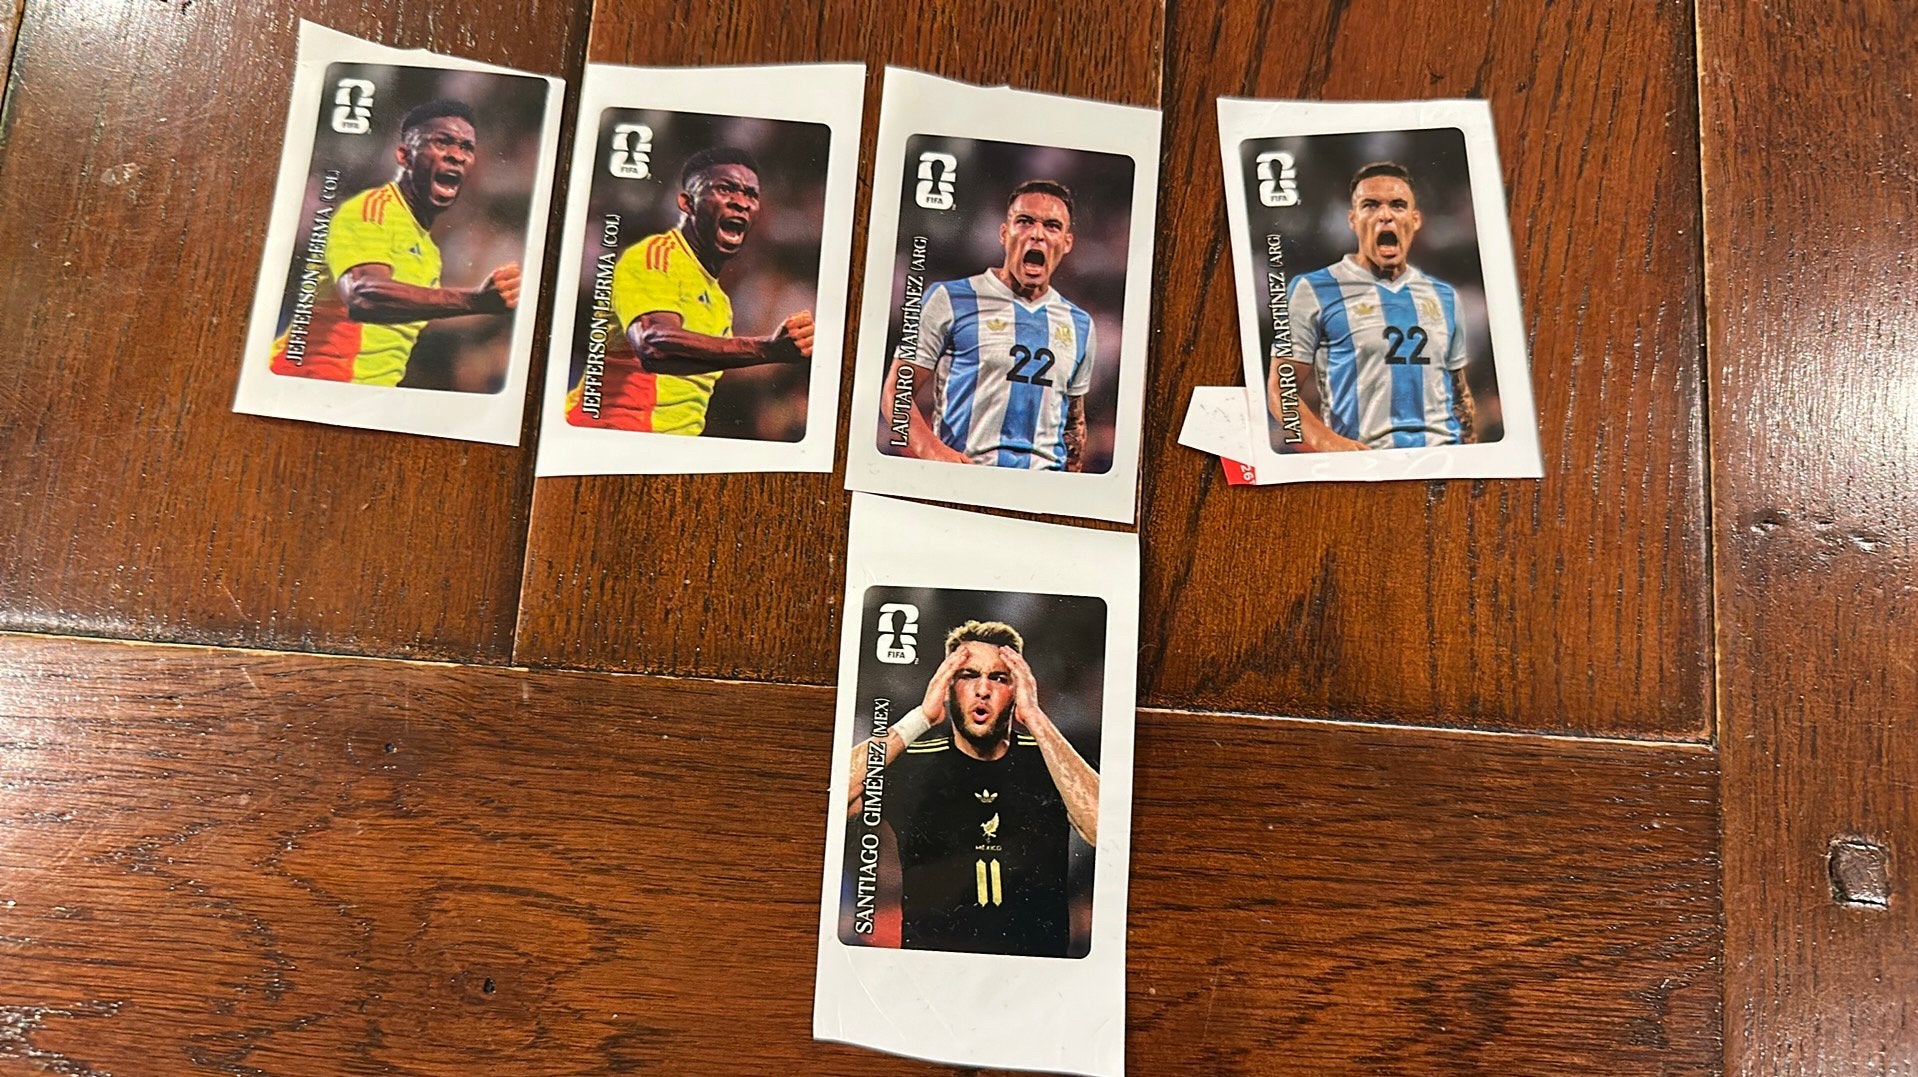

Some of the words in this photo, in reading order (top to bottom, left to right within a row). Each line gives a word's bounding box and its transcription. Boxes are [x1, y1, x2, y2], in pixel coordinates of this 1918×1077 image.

[621, 166, 638, 174] FIFA
[926, 196, 943, 205] FIFA
[602, 214, 621, 247] (COL)
[910, 236, 929, 271] (ARG)
[1266, 234, 1284, 267] (ARG)
[286, 269, 320, 366] JEFFERSON
[306, 207, 333, 263] LERMA
[592, 253, 616, 311] LERMA
[901, 275, 923, 361] MARTÍNEZ
[1269, 271, 1293, 358] MARTÍNEZ
[582, 317, 608, 419] JEFFERSON
[1006, 345, 1055, 387] 22
[1383, 326, 1431, 365] 22
[891, 365, 914, 446] LAUTARO
[1276, 364, 1302, 444] LAUTARO
[887, 650, 905, 659] FIFA
[872, 698, 891, 736] (MEX)
[863, 741, 887, 828] GIMÉNEZ
[855, 833, 879, 934] SANTIAGO
[976, 859, 1002, 907] 11
